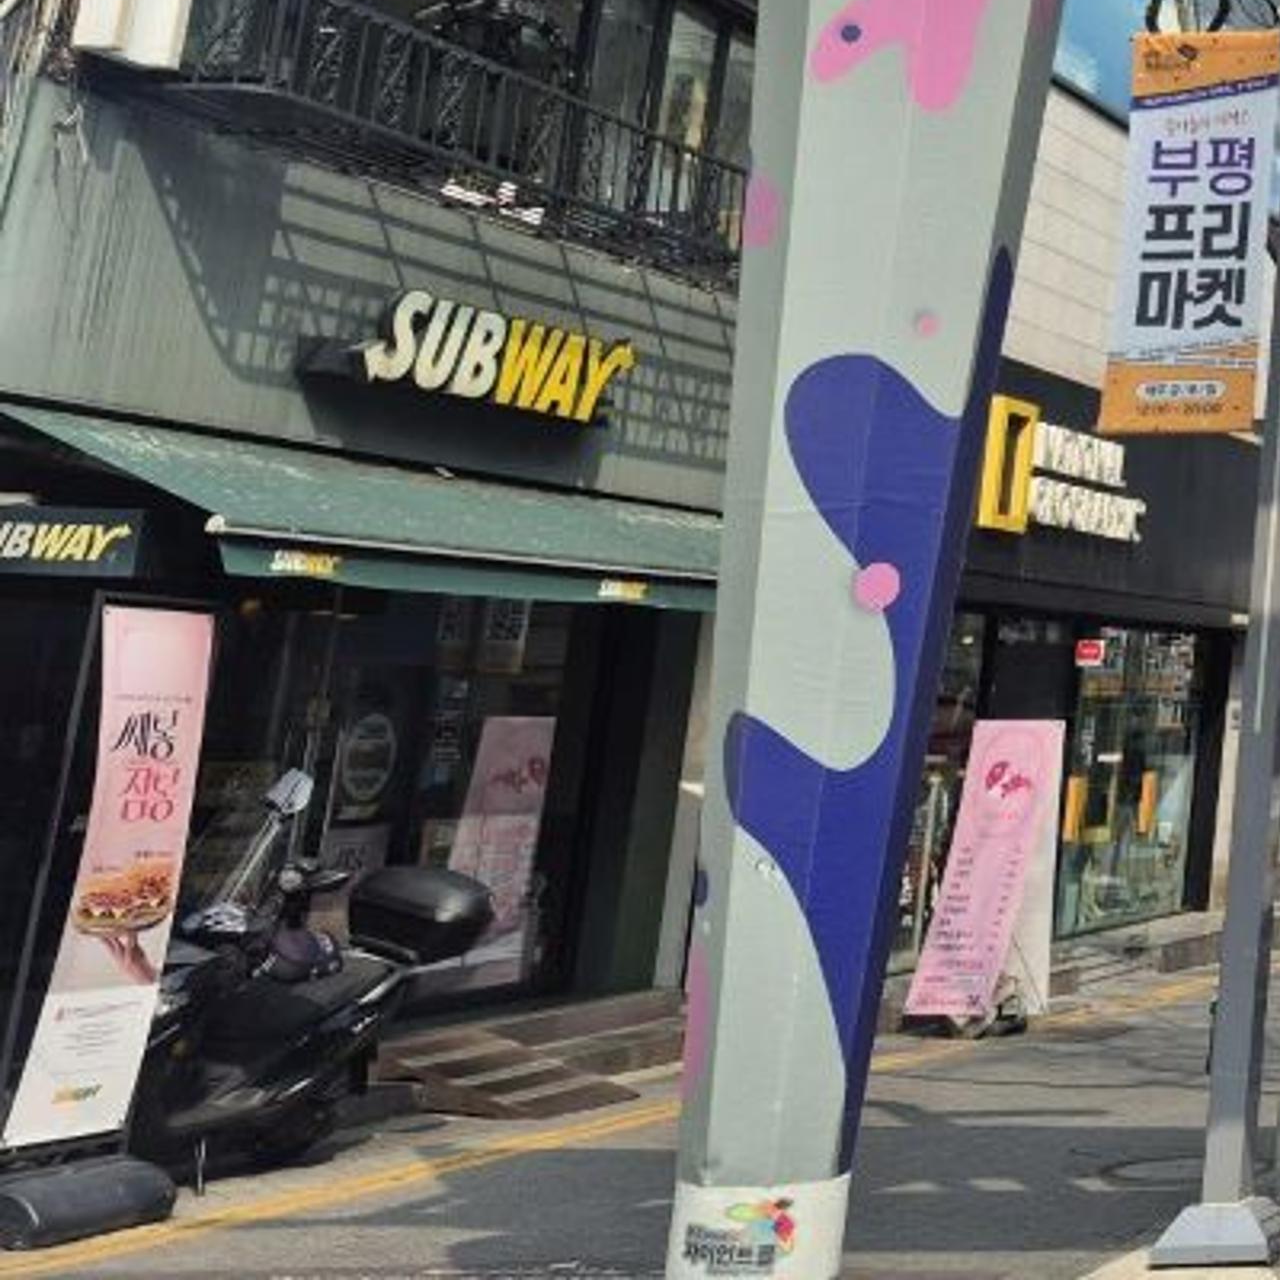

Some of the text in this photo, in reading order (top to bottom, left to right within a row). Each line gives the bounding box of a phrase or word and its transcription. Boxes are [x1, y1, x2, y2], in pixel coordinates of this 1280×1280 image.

[1148, 137, 1255, 198] 부평
[1141, 202, 1252, 261] 프리
[1135, 267, 1246, 330] 마켓
[362, 291, 636, 421] SUBWAY
[270, 550, 343, 575] SUBWAY
